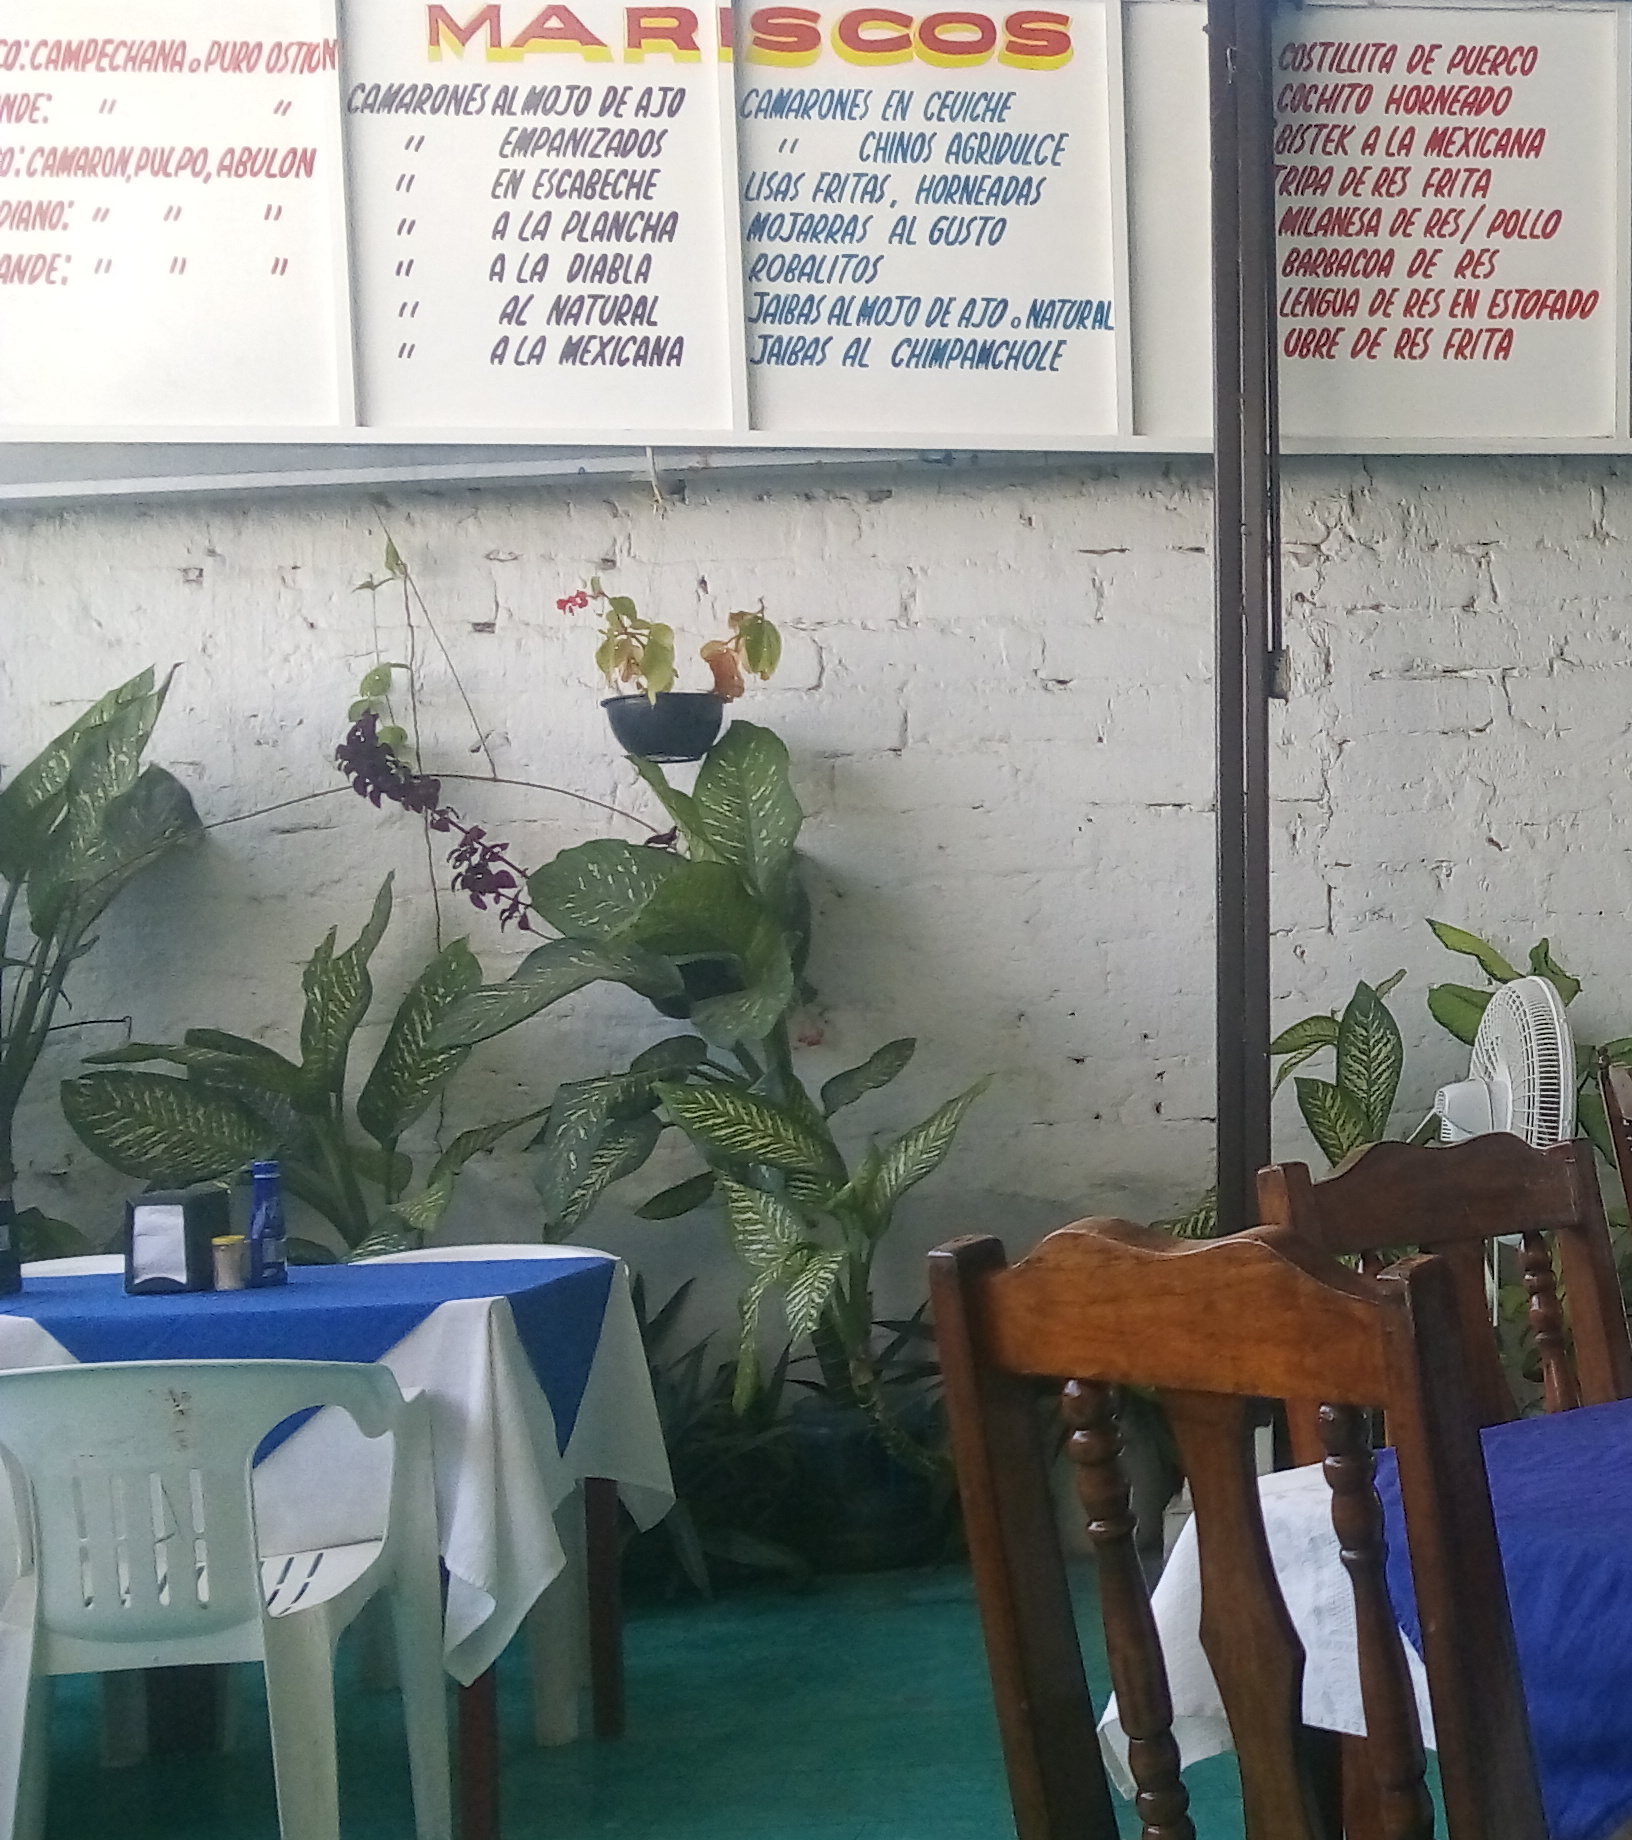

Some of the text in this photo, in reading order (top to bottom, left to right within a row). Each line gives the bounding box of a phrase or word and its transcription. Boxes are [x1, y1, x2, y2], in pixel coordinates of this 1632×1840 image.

[424, 4, 1074, 70] MARISCOS
[204, 40, 263, 73] PURO
[265, 38, 337, 74] OSTION
[1279, 42, 1538, 76] COSTILLITA DE PUERCO
[347, 83, 686, 118] CAMARONES AL MOJO DE AJO
[740, 88, 873, 121] CAMARONES
[881, 90, 914, 122] EN
[1277, 82, 1512, 116] COCHITO HORNEADO
[499, 127, 668, 158] EMPANIZADOS
[859, 131, 936, 164] CHINOS
[945, 132, 1069, 167] AGRIDULCE
[1275, 124, 1546, 159] BISTEK A LA MEXICANA
[135, 147, 212, 184] PULPO,
[216, 147, 317, 178] ABULON
[1338, 165, 1372, 197] DE
[1371, 165, 1412, 198] RES
[1422, 167, 1492, 199] FRITA
[491, 168, 526, 200] EN
[532, 168, 661, 200] ESCABECHE
[745, 171, 1047, 209] LISAS FRITAS, HORNEADAS
[491, 211, 510, 241] A
[518, 210, 552, 242] LA
[561, 210, 679, 243] PLANCHA
[746, 212, 1007, 246] MOJARRAS AL GUSTO
[1279, 206, 1382, 238] MILANESA
[1389, 208, 1422, 239] DE
[1487, 208, 1563, 240] POLLO
[489, 253, 505, 283] A
[516, 253, 549, 283] LA
[566, 253, 652, 284] DIABLA
[749, 254, 885, 284] ROBALITOS
[1281, 247, 1500, 280] BARBACOA DE RES
[499, 294, 535, 326] AL
[546, 294, 659, 327] NATURAL
[748, 291, 827, 327] JAIBAS
[827, 295, 858, 327] AL
[858, 295, 922, 327] MOJO
[925, 297, 956, 328] DE
[958, 297, 1011, 329] AJO
[1026, 299, 1115, 331] NATURAL
[1279, 287, 1600, 320] LENGUA DE RES EN ESTOFADO
[490, 335, 508, 365] A
[513, 335, 546, 366] LA
[558, 335, 685, 367] MEXICANA
[749, 334, 834, 367] JAIBAS
[842, 337, 872, 368] AL
[1283, 327, 1514, 361] UBRE DE RES FRITA
